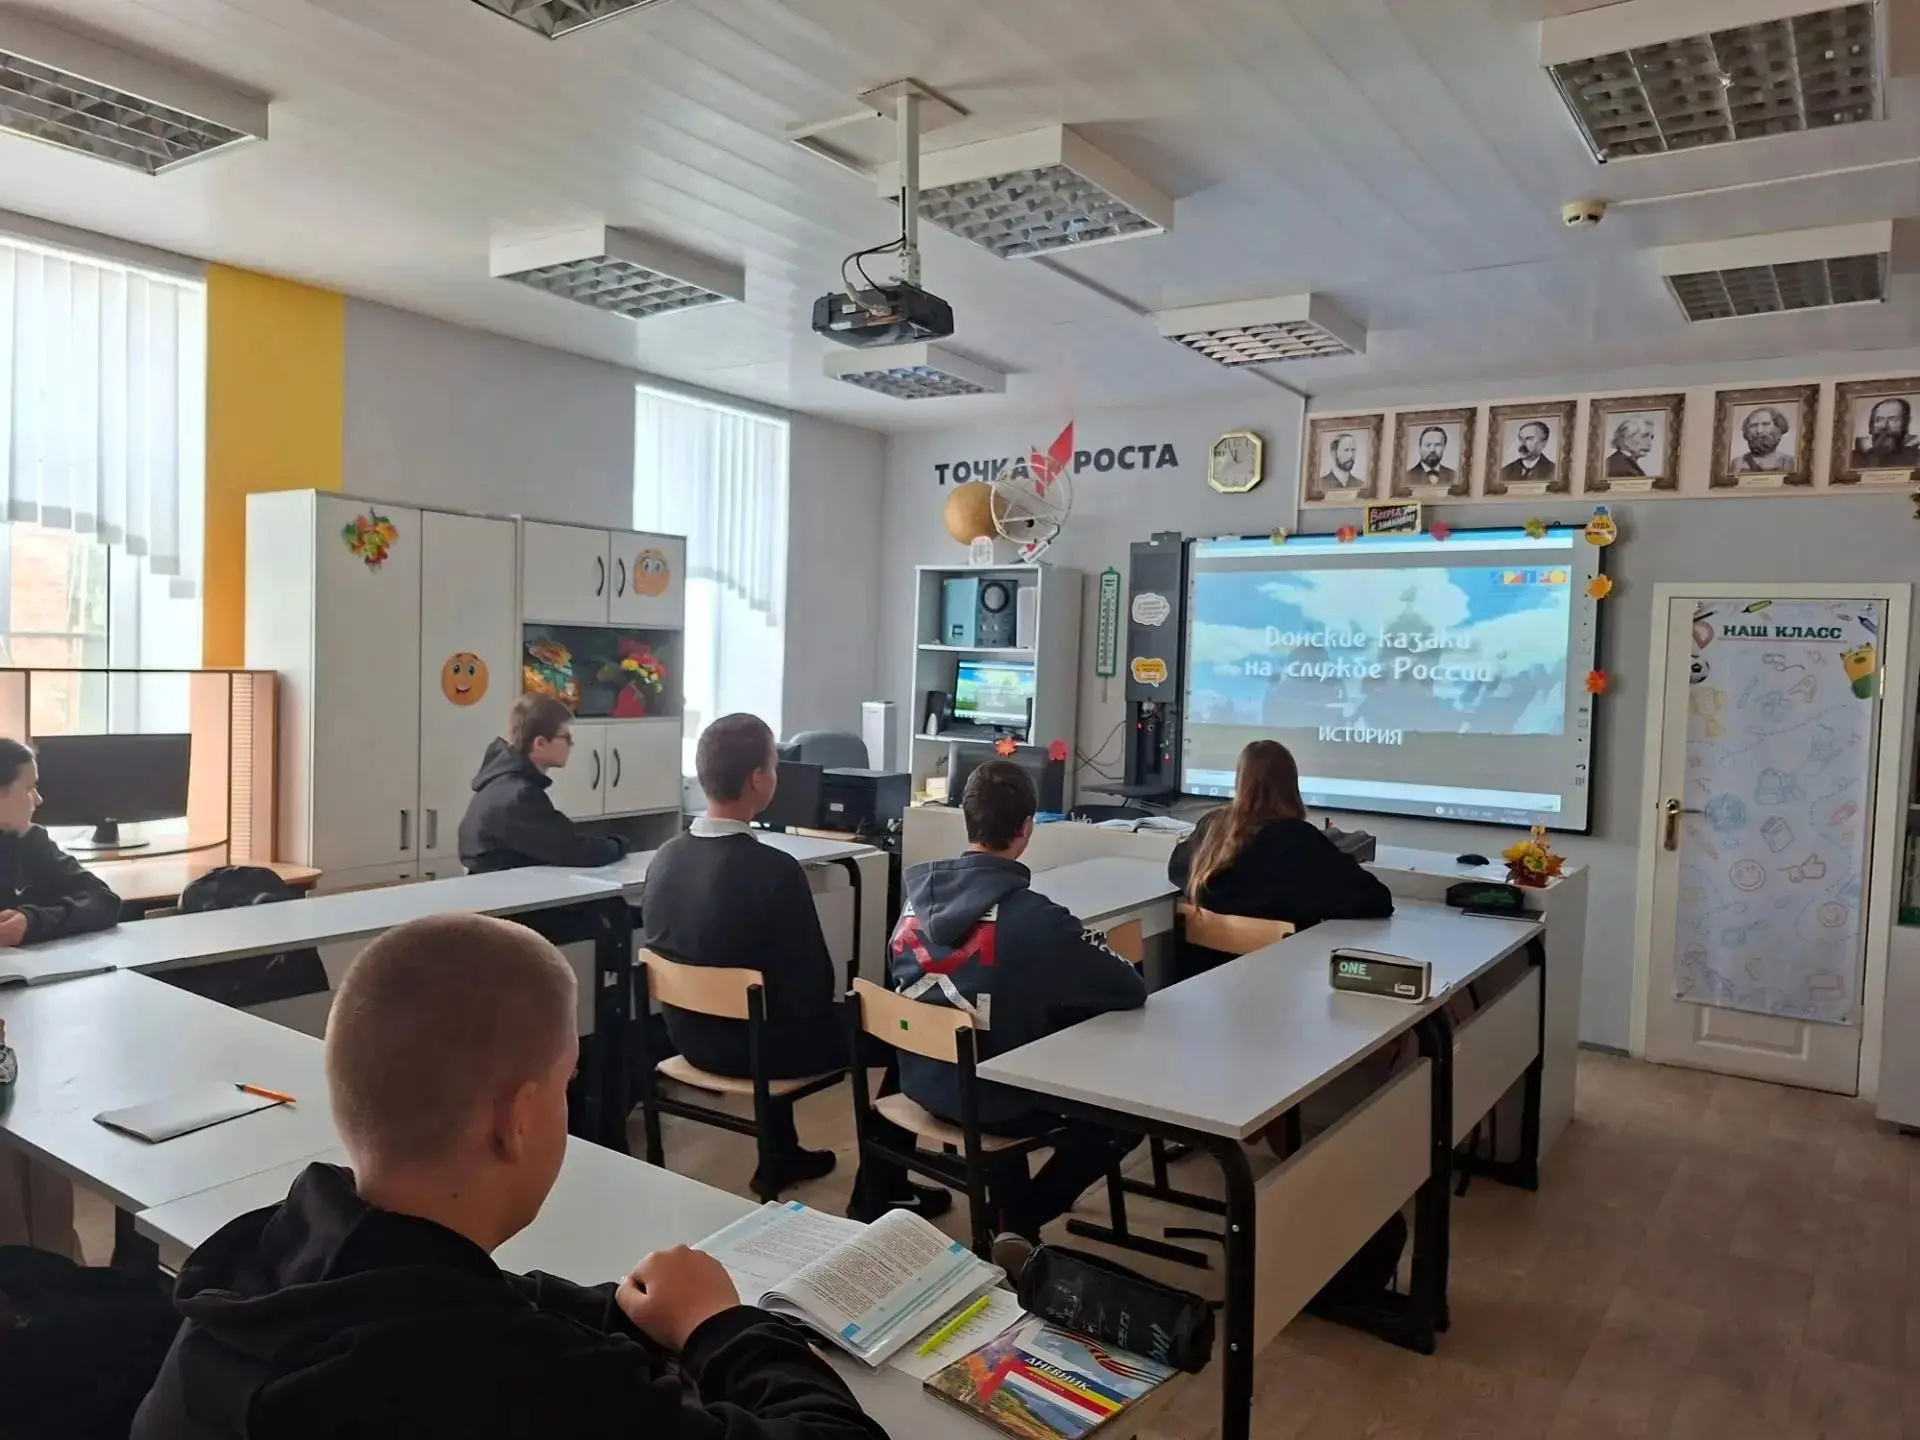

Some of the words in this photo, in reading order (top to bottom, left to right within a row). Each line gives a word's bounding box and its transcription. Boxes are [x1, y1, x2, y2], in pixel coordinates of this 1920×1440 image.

[935, 457, 1030, 485] ТОЧКА
[1074, 443, 1179, 474] РОСТА
[1265, 626, 1367, 649] Донские
[1378, 627, 1471, 653] казаки
[1723, 625, 1768, 638] НАШ
[1775, 626, 1842, 640] КЛАСС
[1245, 659, 1272, 678] на
[1287, 656, 1383, 683] службе
[1393, 656, 1493, 683] России
[1317, 725, 1403, 746] ИСТОРИЯ
[1339, 961, 1368, 976] ONE
[1024, 1357, 1091, 1392] ДНЕВНИК
